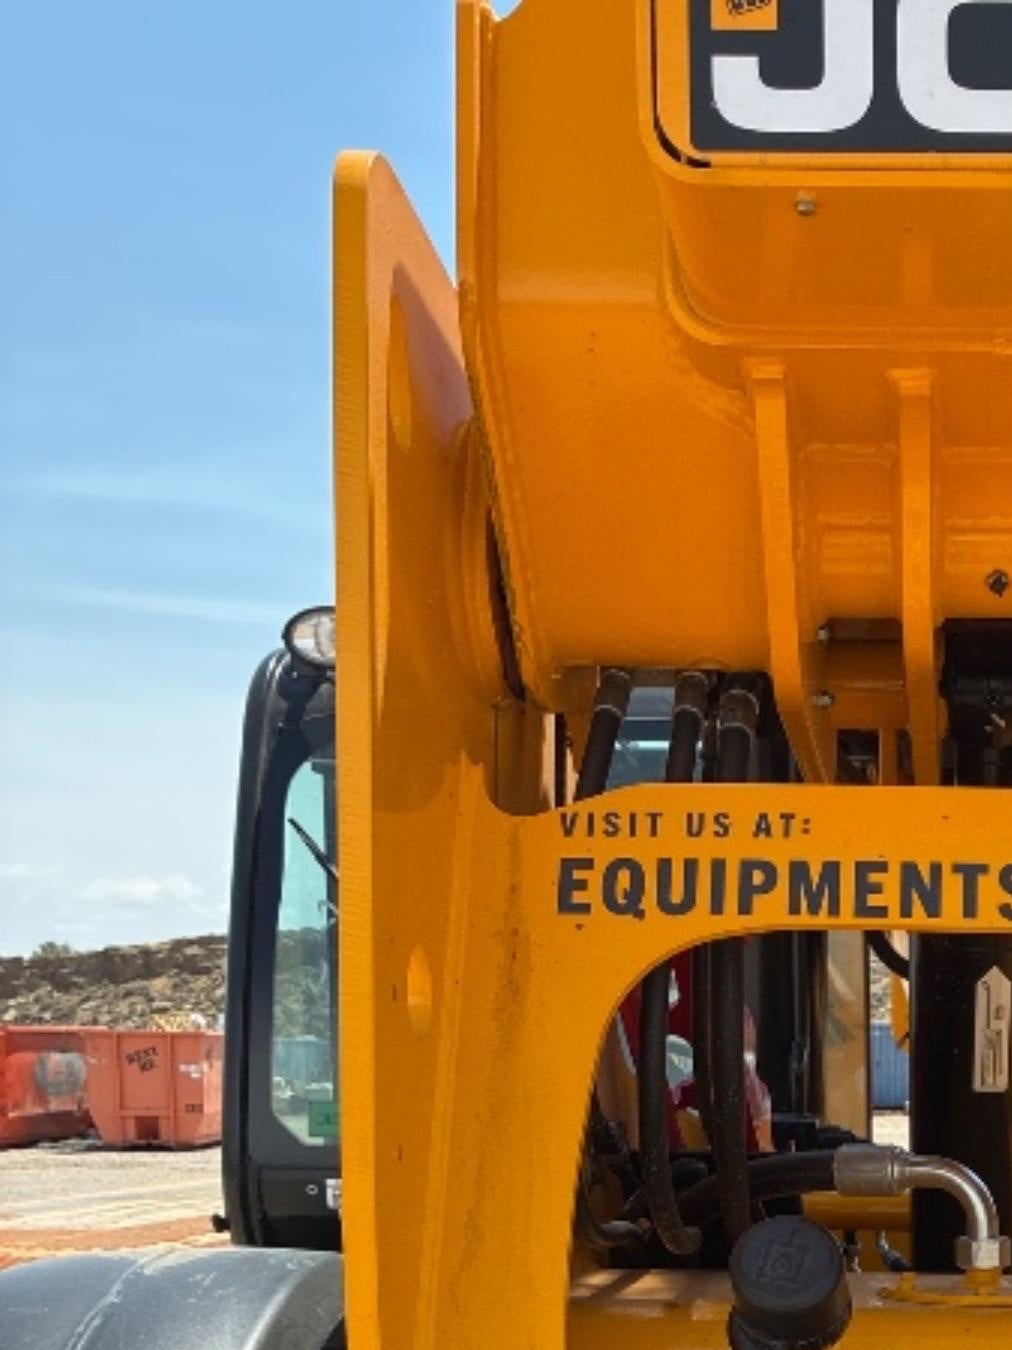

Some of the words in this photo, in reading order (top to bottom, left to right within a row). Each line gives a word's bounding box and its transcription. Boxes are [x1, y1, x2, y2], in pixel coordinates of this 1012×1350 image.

[560, 811, 663, 836] VISIT
[686, 813, 730, 837] US
[752, 815, 809, 838] AT:
